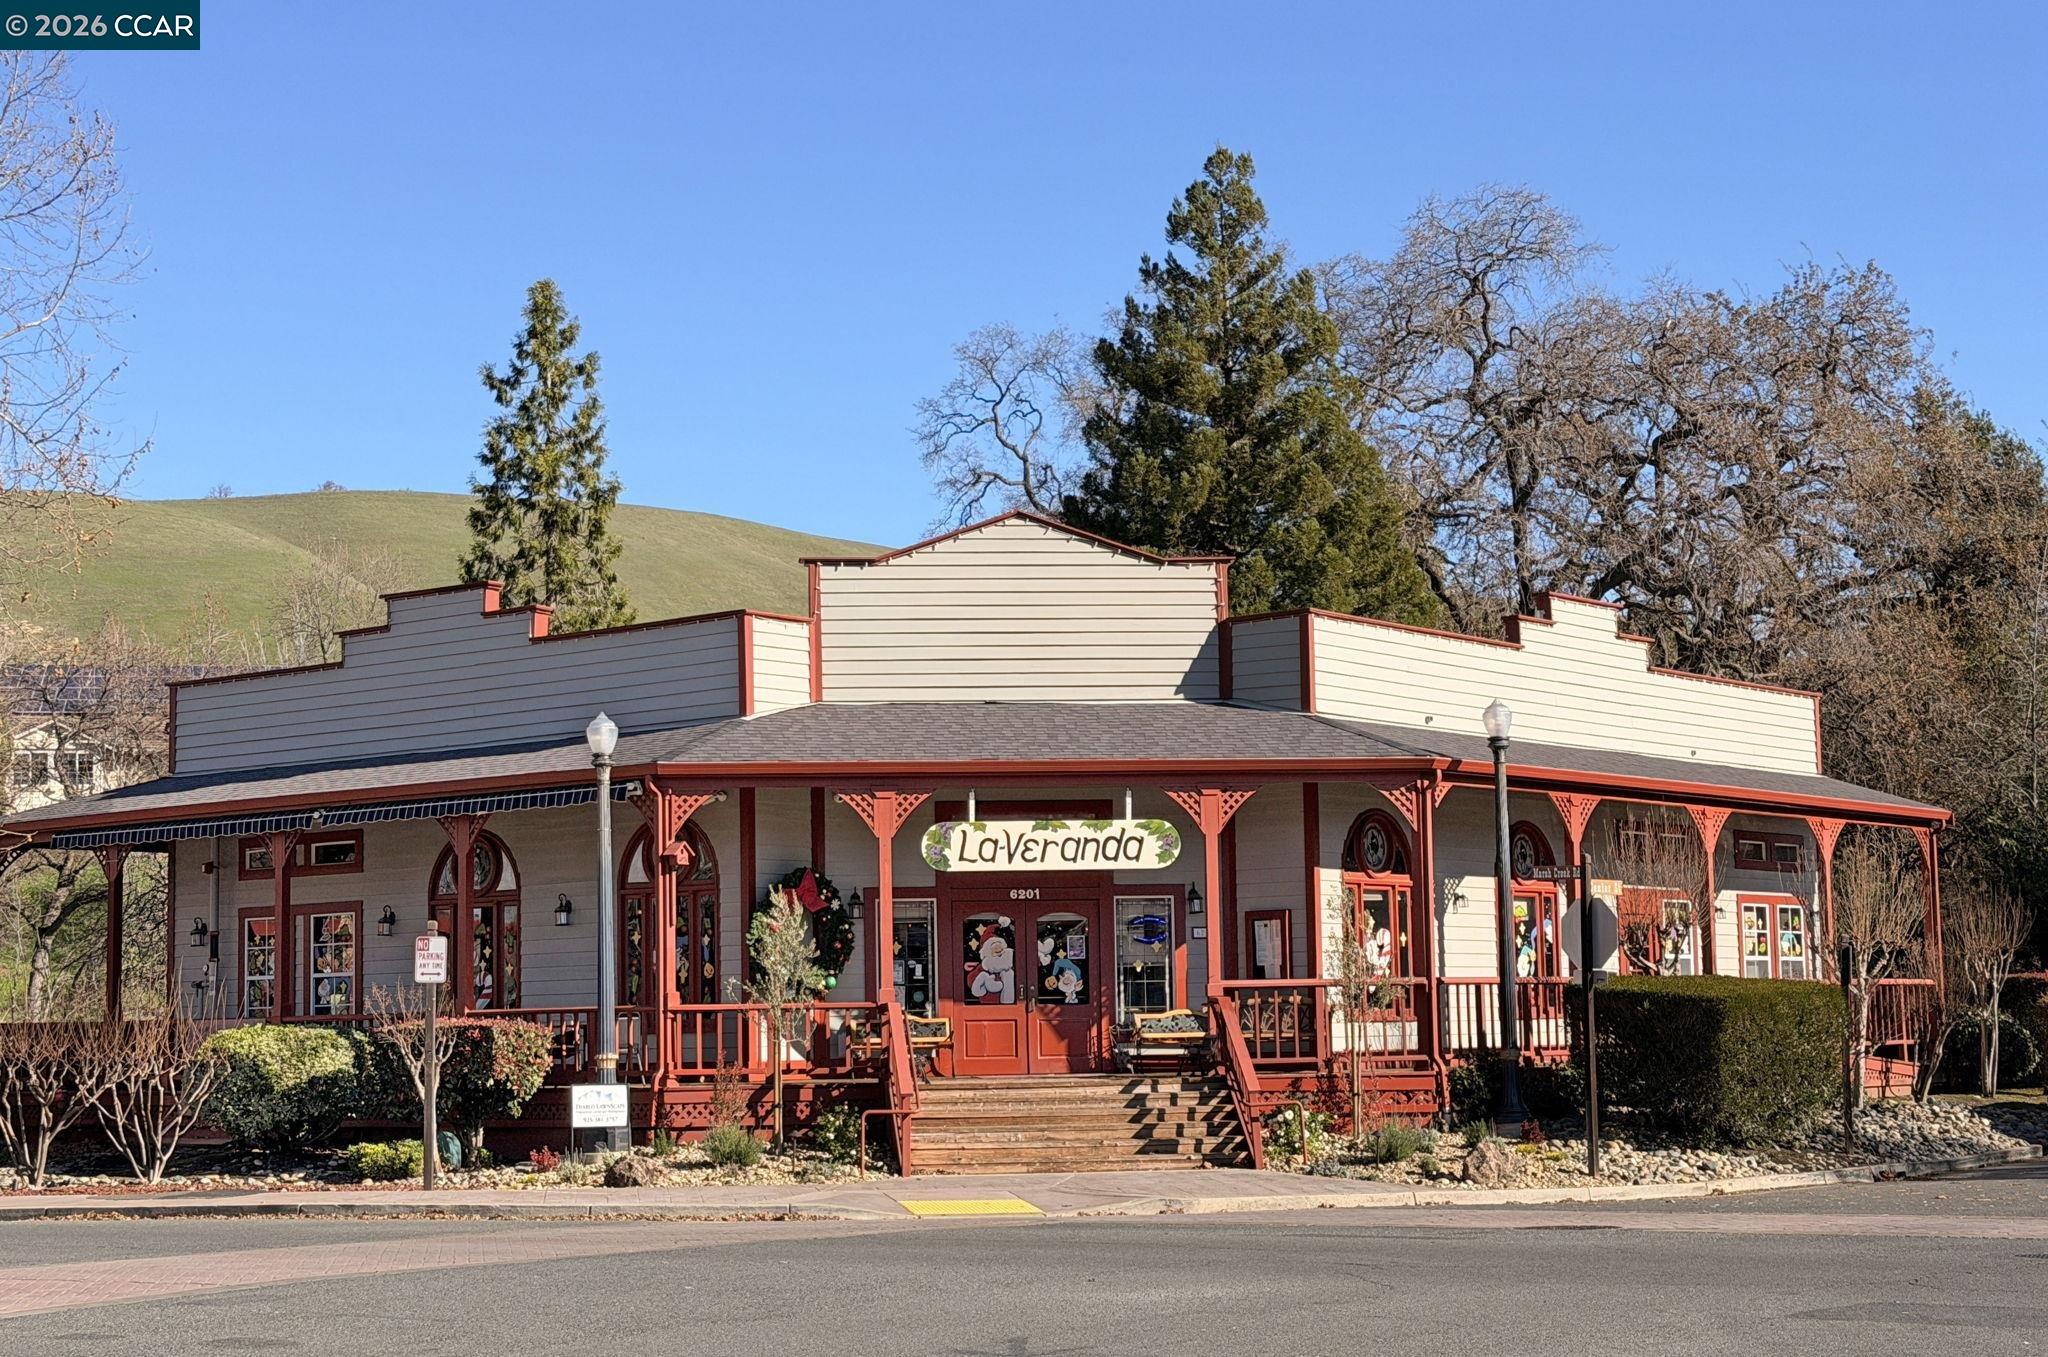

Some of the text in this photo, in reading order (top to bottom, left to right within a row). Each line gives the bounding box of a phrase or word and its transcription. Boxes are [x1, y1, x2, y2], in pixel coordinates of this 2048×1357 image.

[958, 827, 1144, 864] La-Veranda
[1533, 867, 1580, 878] Marsh Creek Rd
[1009, 888, 1040, 900] 6201
[417, 939, 429, 950] NO
[418, 952, 445, 961] PARKING
[432, 962, 443, 970] TIME
